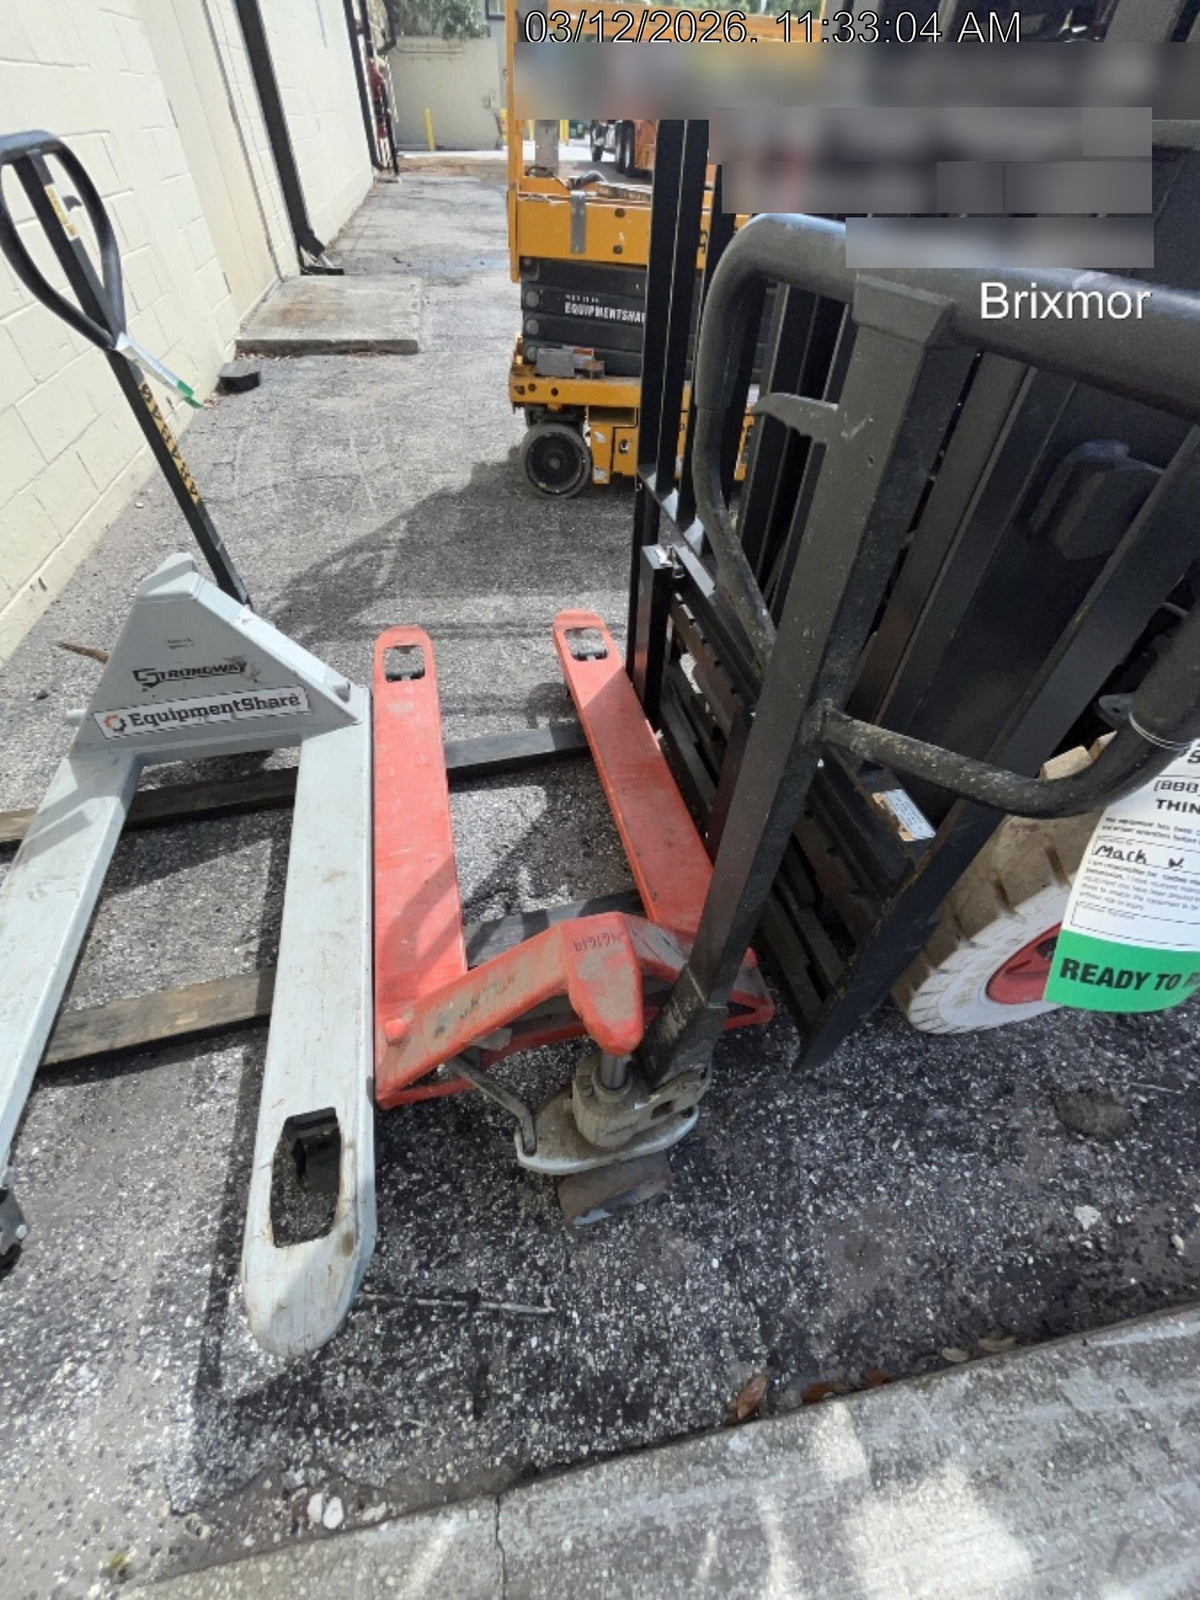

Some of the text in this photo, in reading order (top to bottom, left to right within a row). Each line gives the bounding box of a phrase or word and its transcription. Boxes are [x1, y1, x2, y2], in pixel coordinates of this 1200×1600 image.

[127, 693, 302, 728] EquipmentShare
[1060, 958, 1151, 991] READY
[1154, 973, 1183, 991] TO
